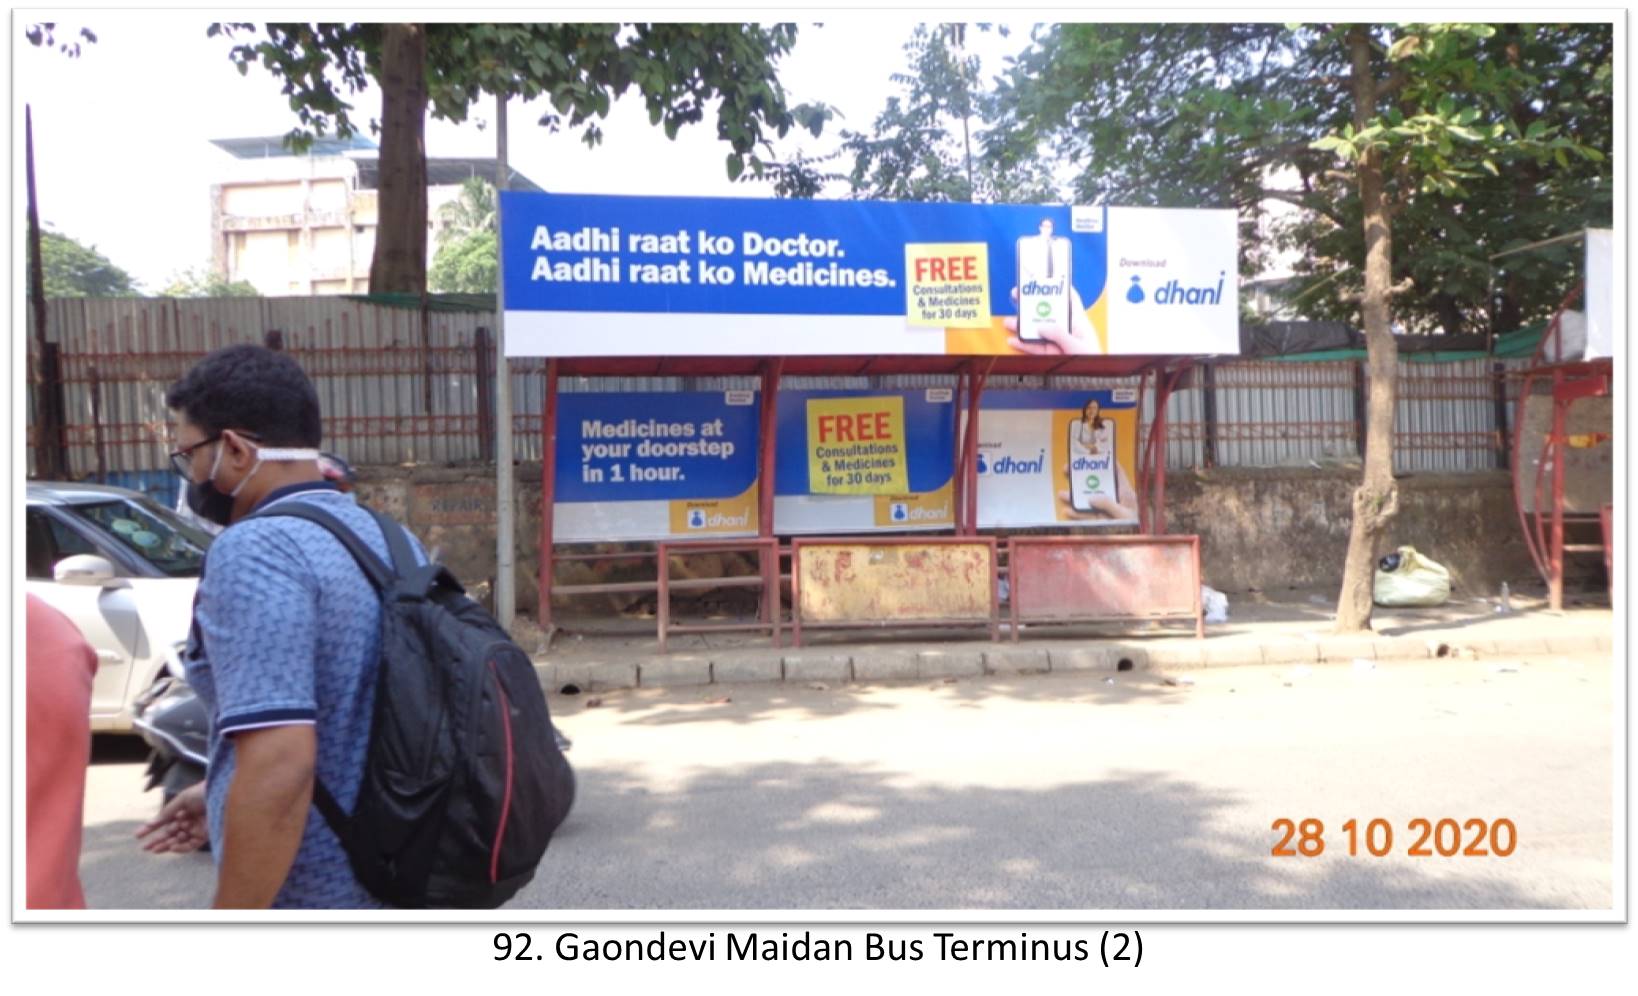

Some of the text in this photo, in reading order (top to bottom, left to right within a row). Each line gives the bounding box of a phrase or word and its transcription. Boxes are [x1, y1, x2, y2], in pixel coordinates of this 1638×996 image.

[530, 225, 845, 257] Aadhi raat ko Doctor.
[530, 256, 896, 287] Aadhi raat ko Medicines.
[914, 256, 977, 281] FREE
[1119, 257, 1166, 268] Download
[912, 283, 983, 296] Consultations
[1022, 275, 1065, 296] dhani
[1154, 271, 1226, 305] dhani
[917, 296, 980, 308] & Medicines
[921, 308, 977, 320] for 30 days
[582, 419, 724, 438] Medicines at
[818, 412, 892, 443] FREE
[582, 440, 734, 462] your doorstep
[816, 444, 898, 458] Consultations
[822, 457, 895, 472] & Medicines
[993, 449, 1045, 475] dhani
[1072, 451, 1111, 471] dhani
[582, 464, 685, 482] in 1 hour.
[827, 473, 892, 486] for 30 days
